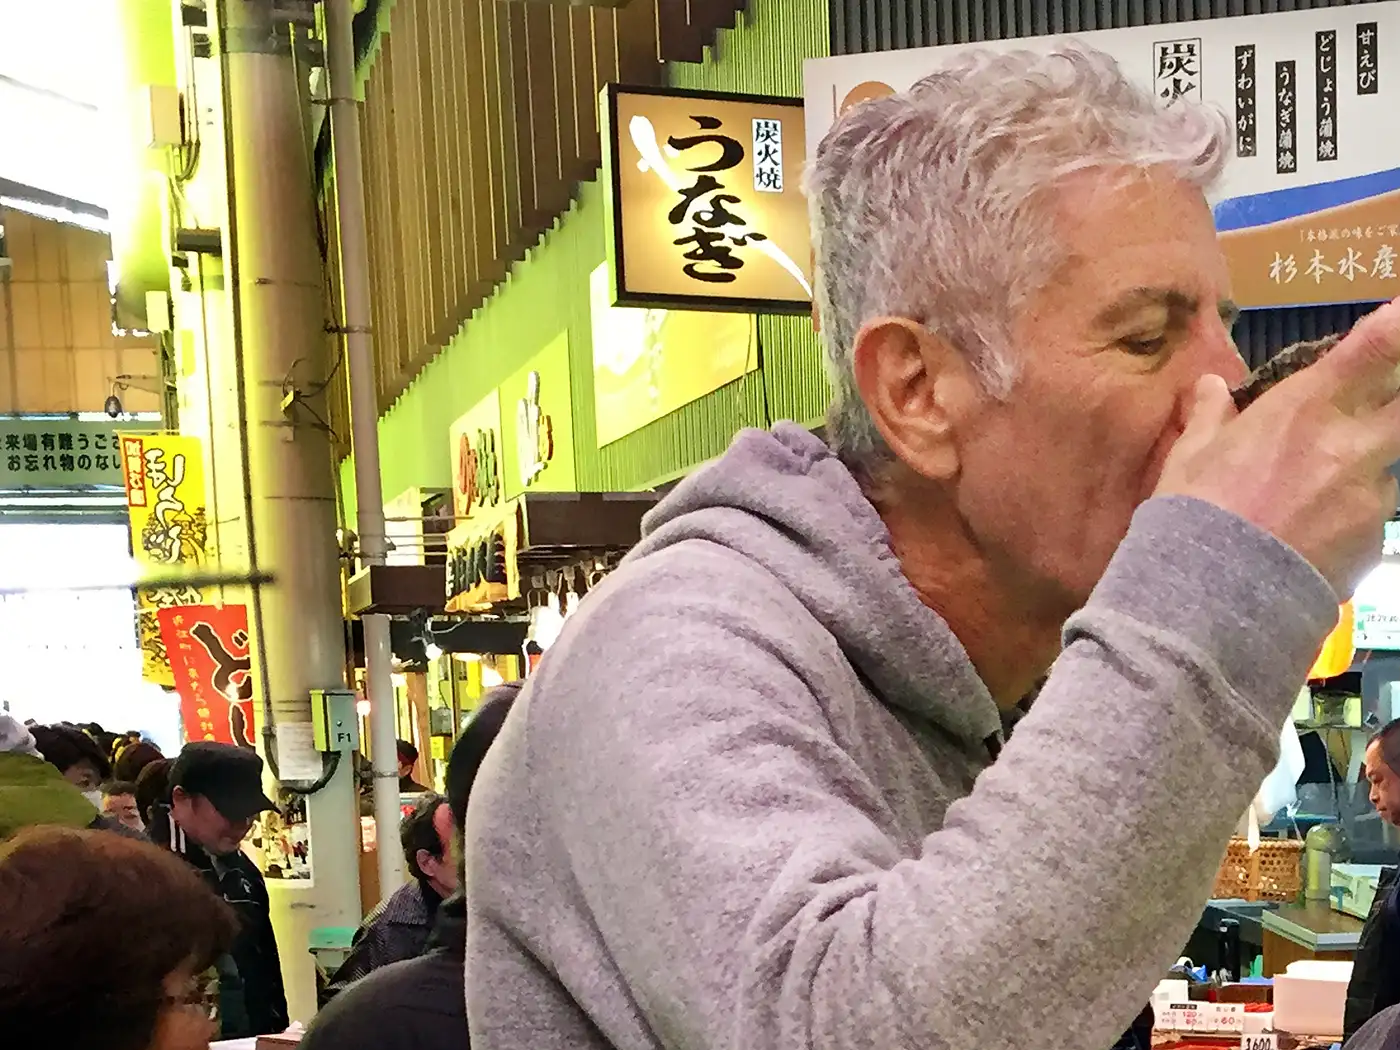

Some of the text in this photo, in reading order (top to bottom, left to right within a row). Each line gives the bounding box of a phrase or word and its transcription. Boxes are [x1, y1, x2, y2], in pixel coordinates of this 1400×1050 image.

[1237, 50, 1254, 152] ずわいがに
[1318, 34, 1335, 158] どじょう蒲焼
[1358, 29, 1376, 89] 甘えび
[755, 121, 781, 190] 炭火焼
[1278, 66, 1295, 170] うなぎ蒲焼
[667, 115, 767, 283] うなぎ
[337, 732, 352, 743] F1
